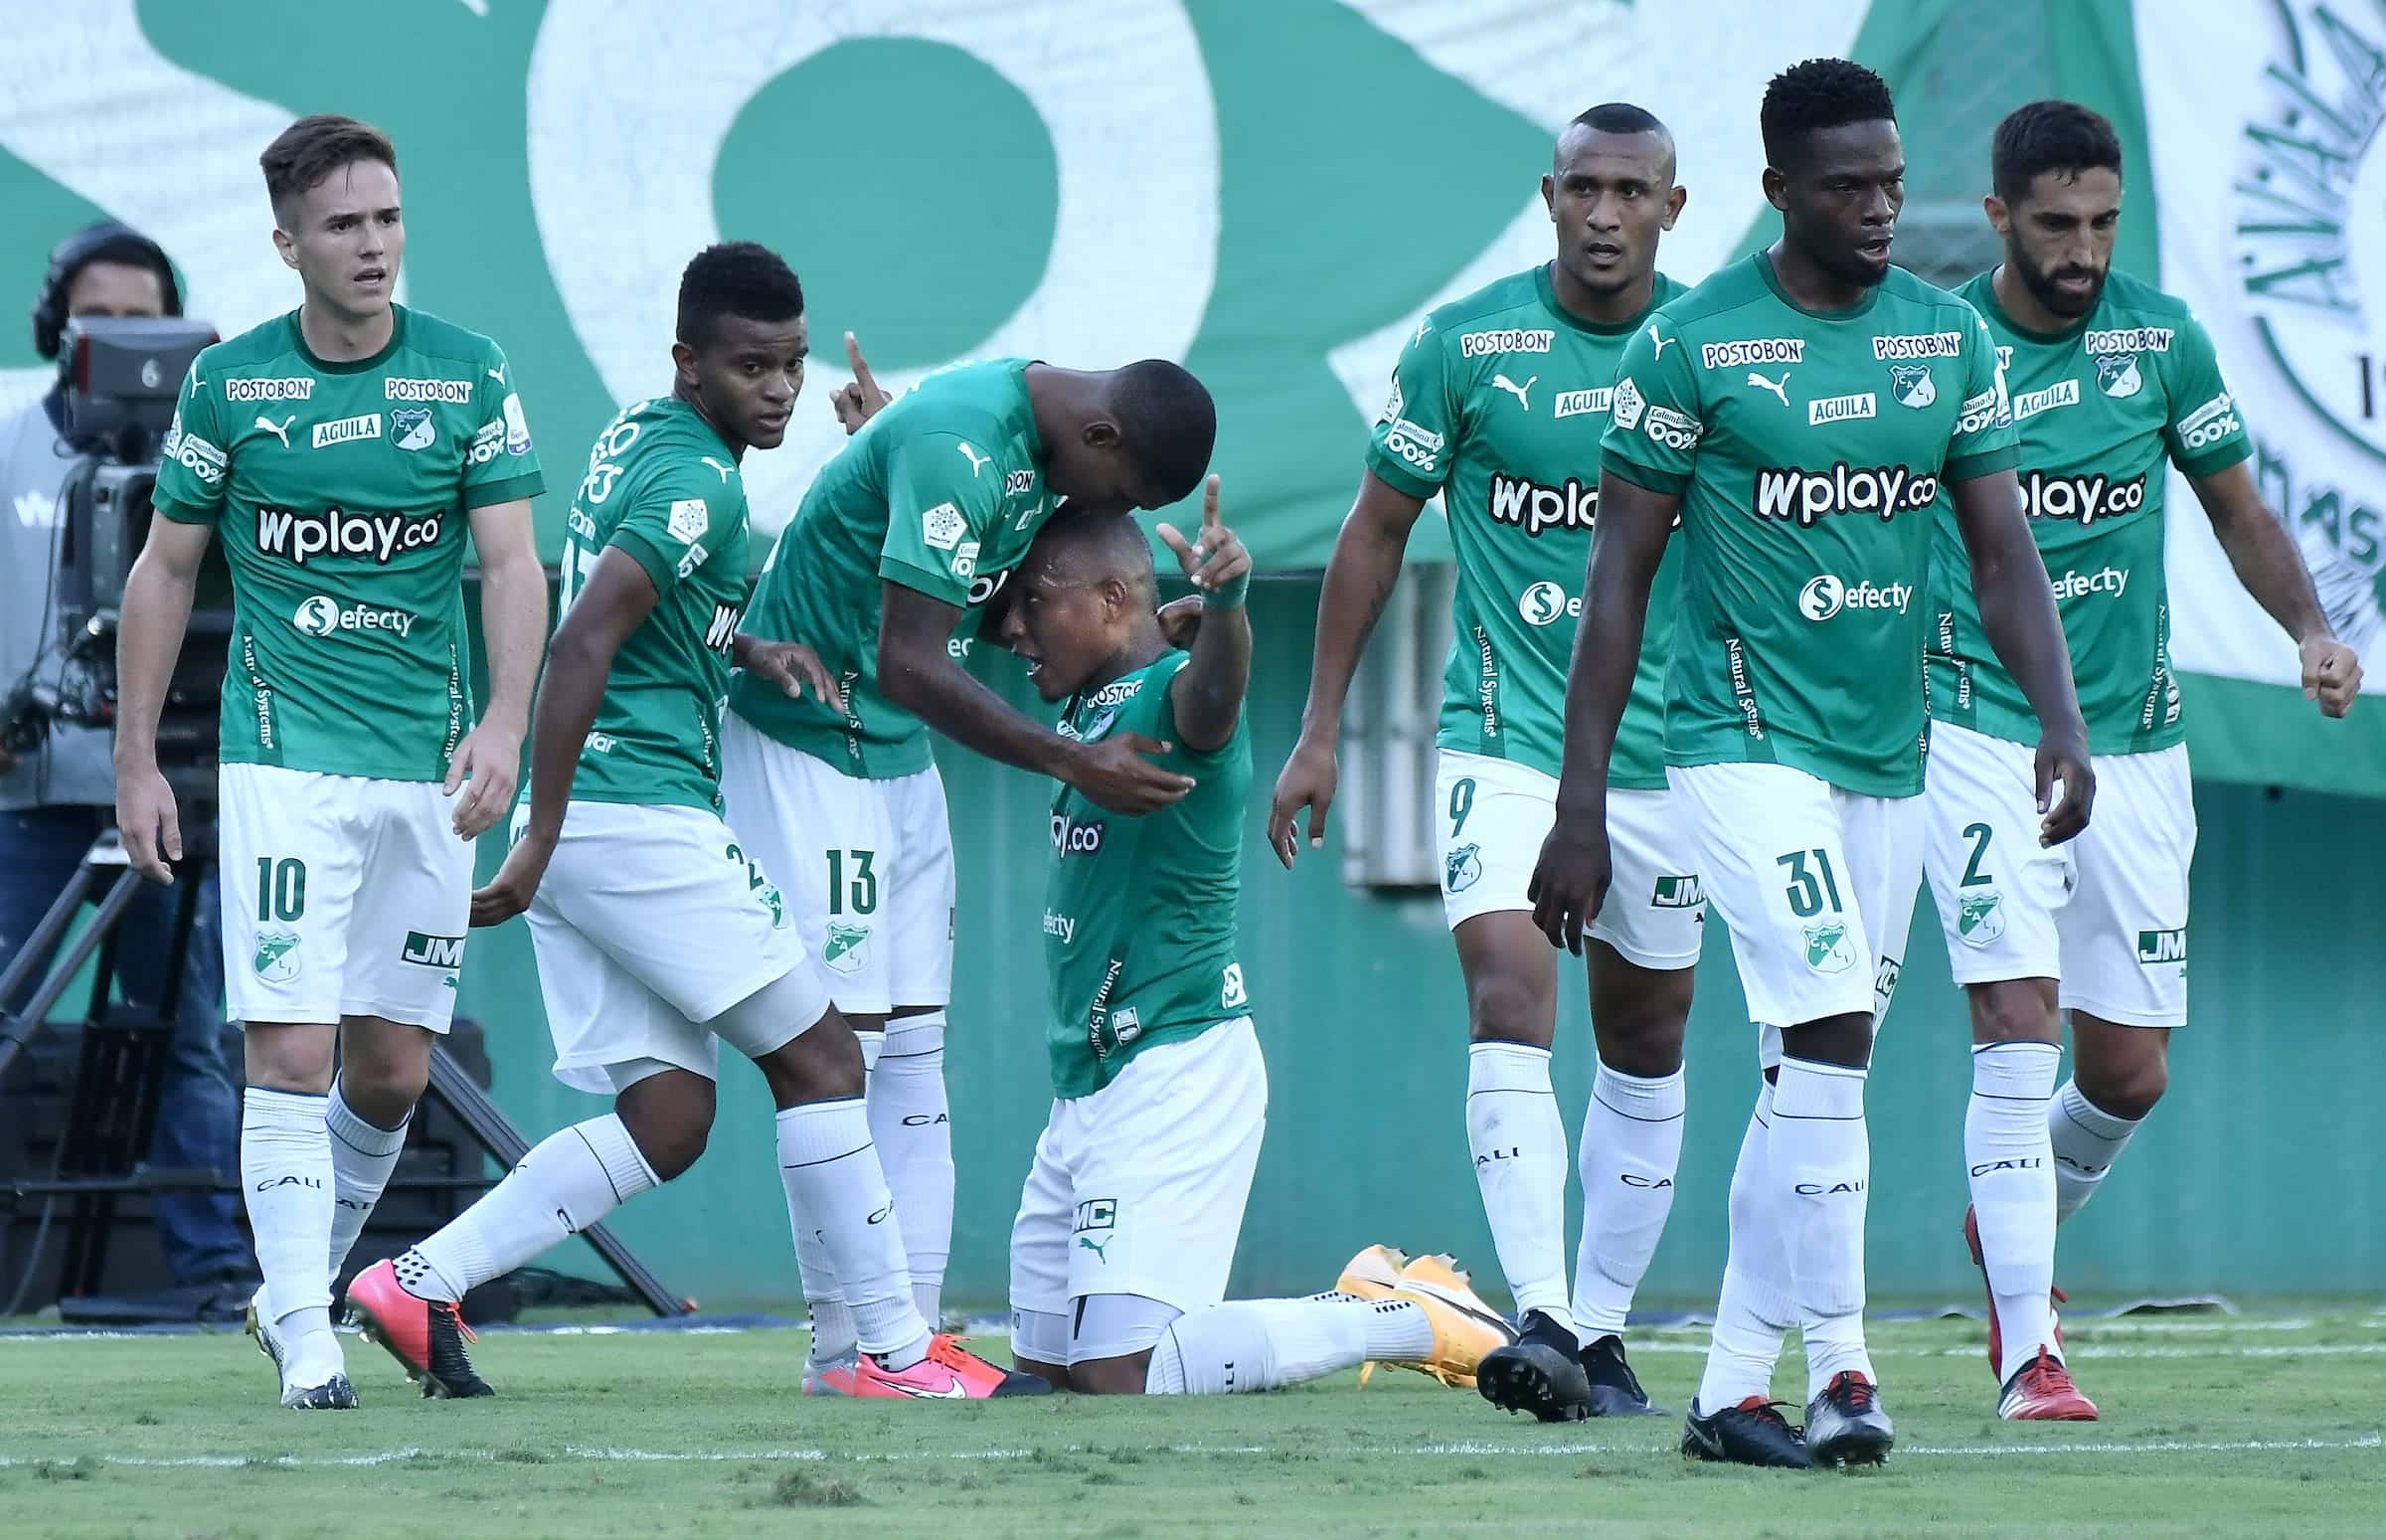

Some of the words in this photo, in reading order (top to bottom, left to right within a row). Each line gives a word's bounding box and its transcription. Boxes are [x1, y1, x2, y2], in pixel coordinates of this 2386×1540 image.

[1463, 331, 1551, 354] POSTOBON
[1705, 341, 1801, 367] POSTOBON
[1875, 335, 1959, 358] POSTOBON
[2087, 329, 2168, 352] POSTOBON
[141, 358, 160, 389] 6
[228, 380, 311, 400] POSTOBON
[386, 380, 467, 402] POSTOBON
[1898, 376, 1931, 403] CALI
[2020, 388, 2074, 415] AGUILA
[1813, 398, 1872, 423] AGUILA
[317, 418, 376, 443] AGUILA
[398, 420, 428, 444] CALI
[1758, 464, 1937, 523] Wplay.co
[258, 509, 441, 564] Wplay.co
[1845, 580, 1913, 614] efecty
[338, 602, 416, 638] efecty
[1473, 624, 1497, 678] Natural
[1725, 637, 1753, 698] Natural
[255, 688, 275, 750] Systems
[1478, 677, 1498, 738] Systems
[1448, 777, 1476, 838] 9
[1960, 822, 1993, 887] 2
[256, 856, 307, 923] 10
[825, 849, 877, 916] 13
[1776, 848, 1843, 918] 31
[1963, 906, 1996, 935] CALI
[259, 942, 293, 976] CALI
[1810, 938, 1849, 963] CALI
[1970, 1157, 2041, 1177] CALI
[256, 1175, 321, 1193] CALI
